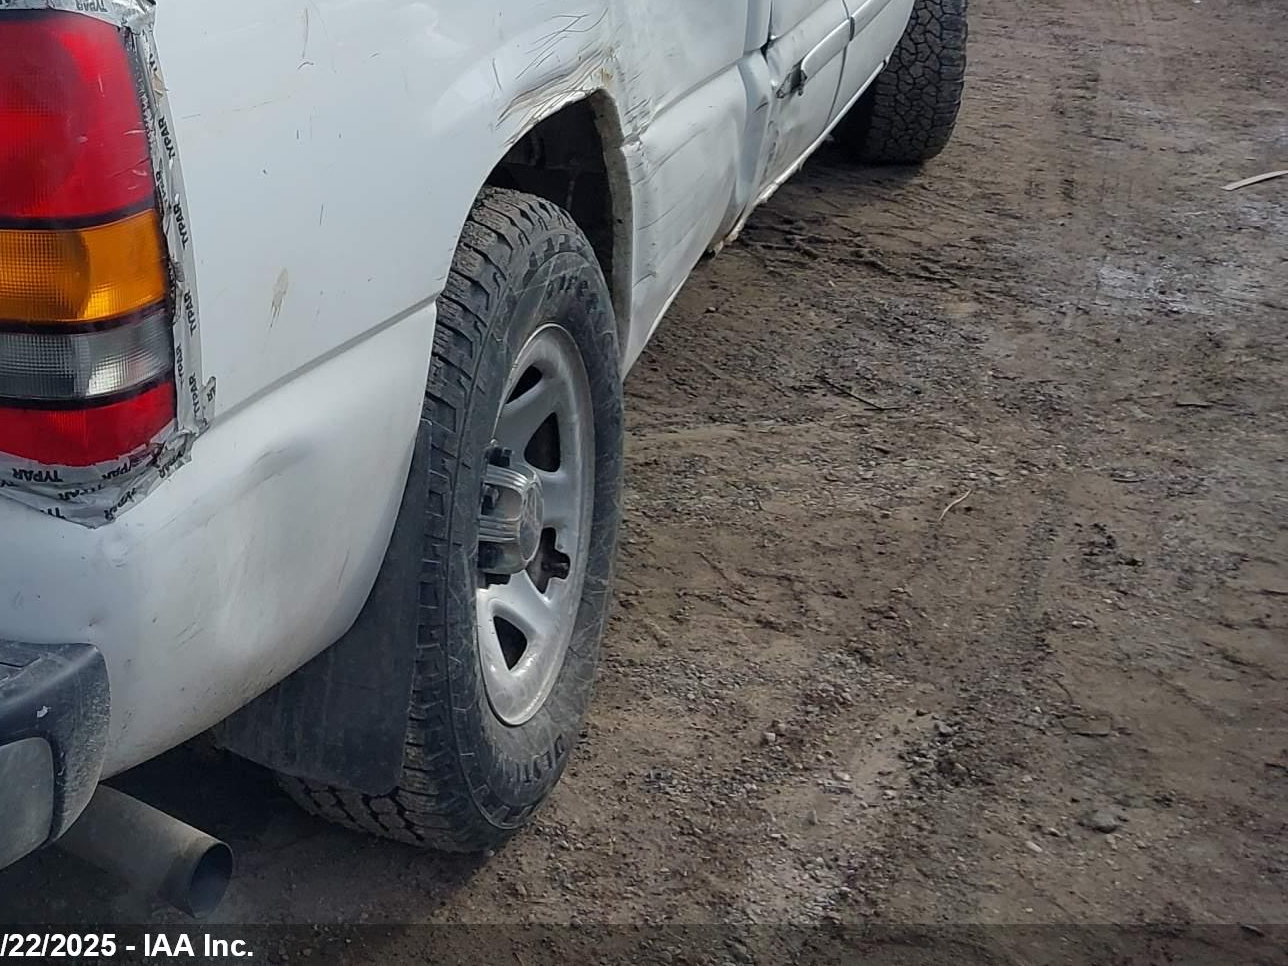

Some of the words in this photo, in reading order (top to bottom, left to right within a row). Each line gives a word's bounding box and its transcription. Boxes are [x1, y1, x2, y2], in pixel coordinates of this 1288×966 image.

[157, 115, 176, 160] TYPAR
[173, 203, 189, 250] TYPAR
[184, 290, 197, 337] TYPAR
[189, 372, 201, 419] TYPAR
[12, 467, 64, 483] TYPAR
